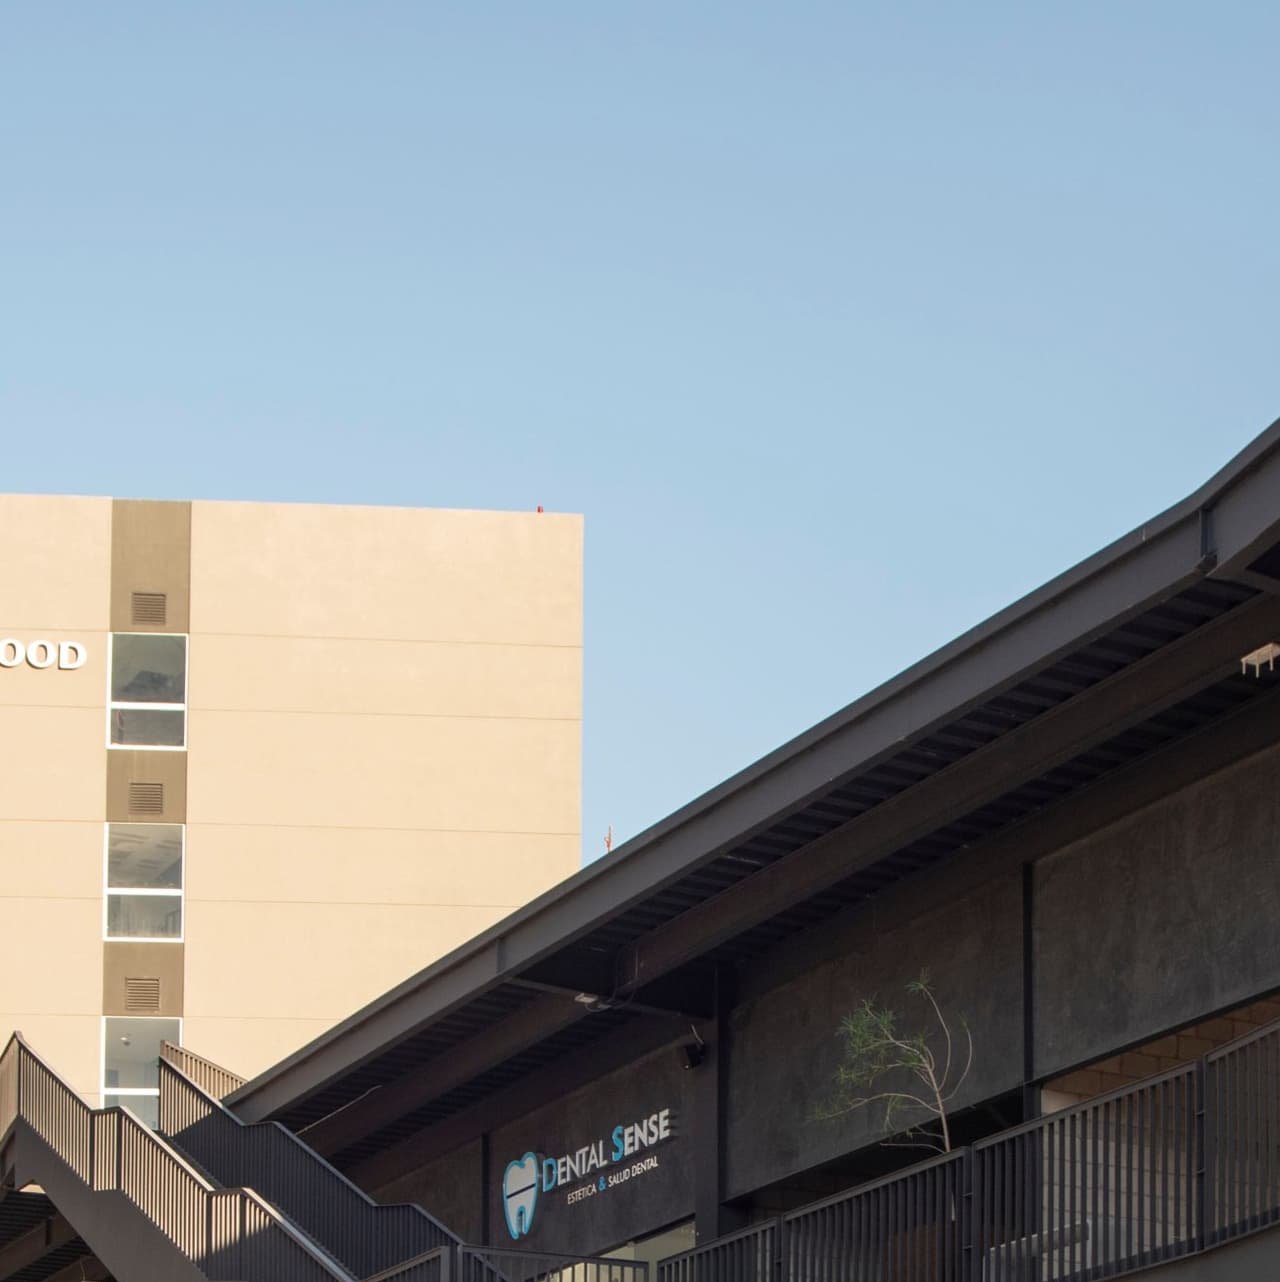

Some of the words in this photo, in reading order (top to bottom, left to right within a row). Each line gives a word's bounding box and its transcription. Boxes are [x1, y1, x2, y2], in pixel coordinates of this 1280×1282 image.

[543, 1139, 608, 1192] DENTAL
[612, 1108, 670, 1161] SENSE
[598, 1176, 606, 1191] &
[608, 1168, 630, 1187] SALUD
[631, 1156, 658, 1177] DENTAL
